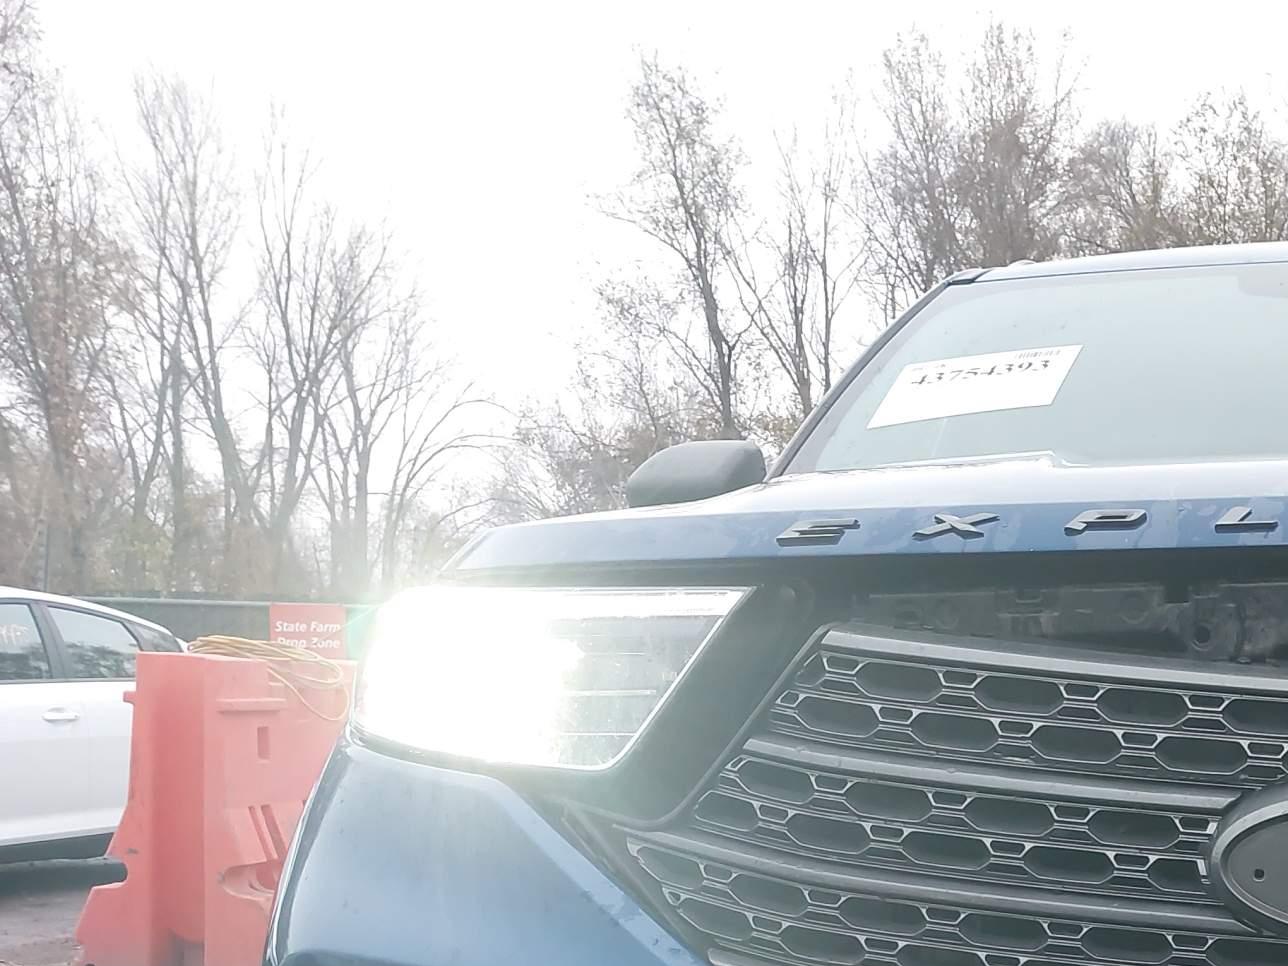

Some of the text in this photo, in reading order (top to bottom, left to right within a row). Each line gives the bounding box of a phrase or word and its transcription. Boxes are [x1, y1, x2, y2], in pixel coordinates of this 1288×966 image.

[275, 620, 341, 633] State Farm
[311, 636, 340, 649] Zone
